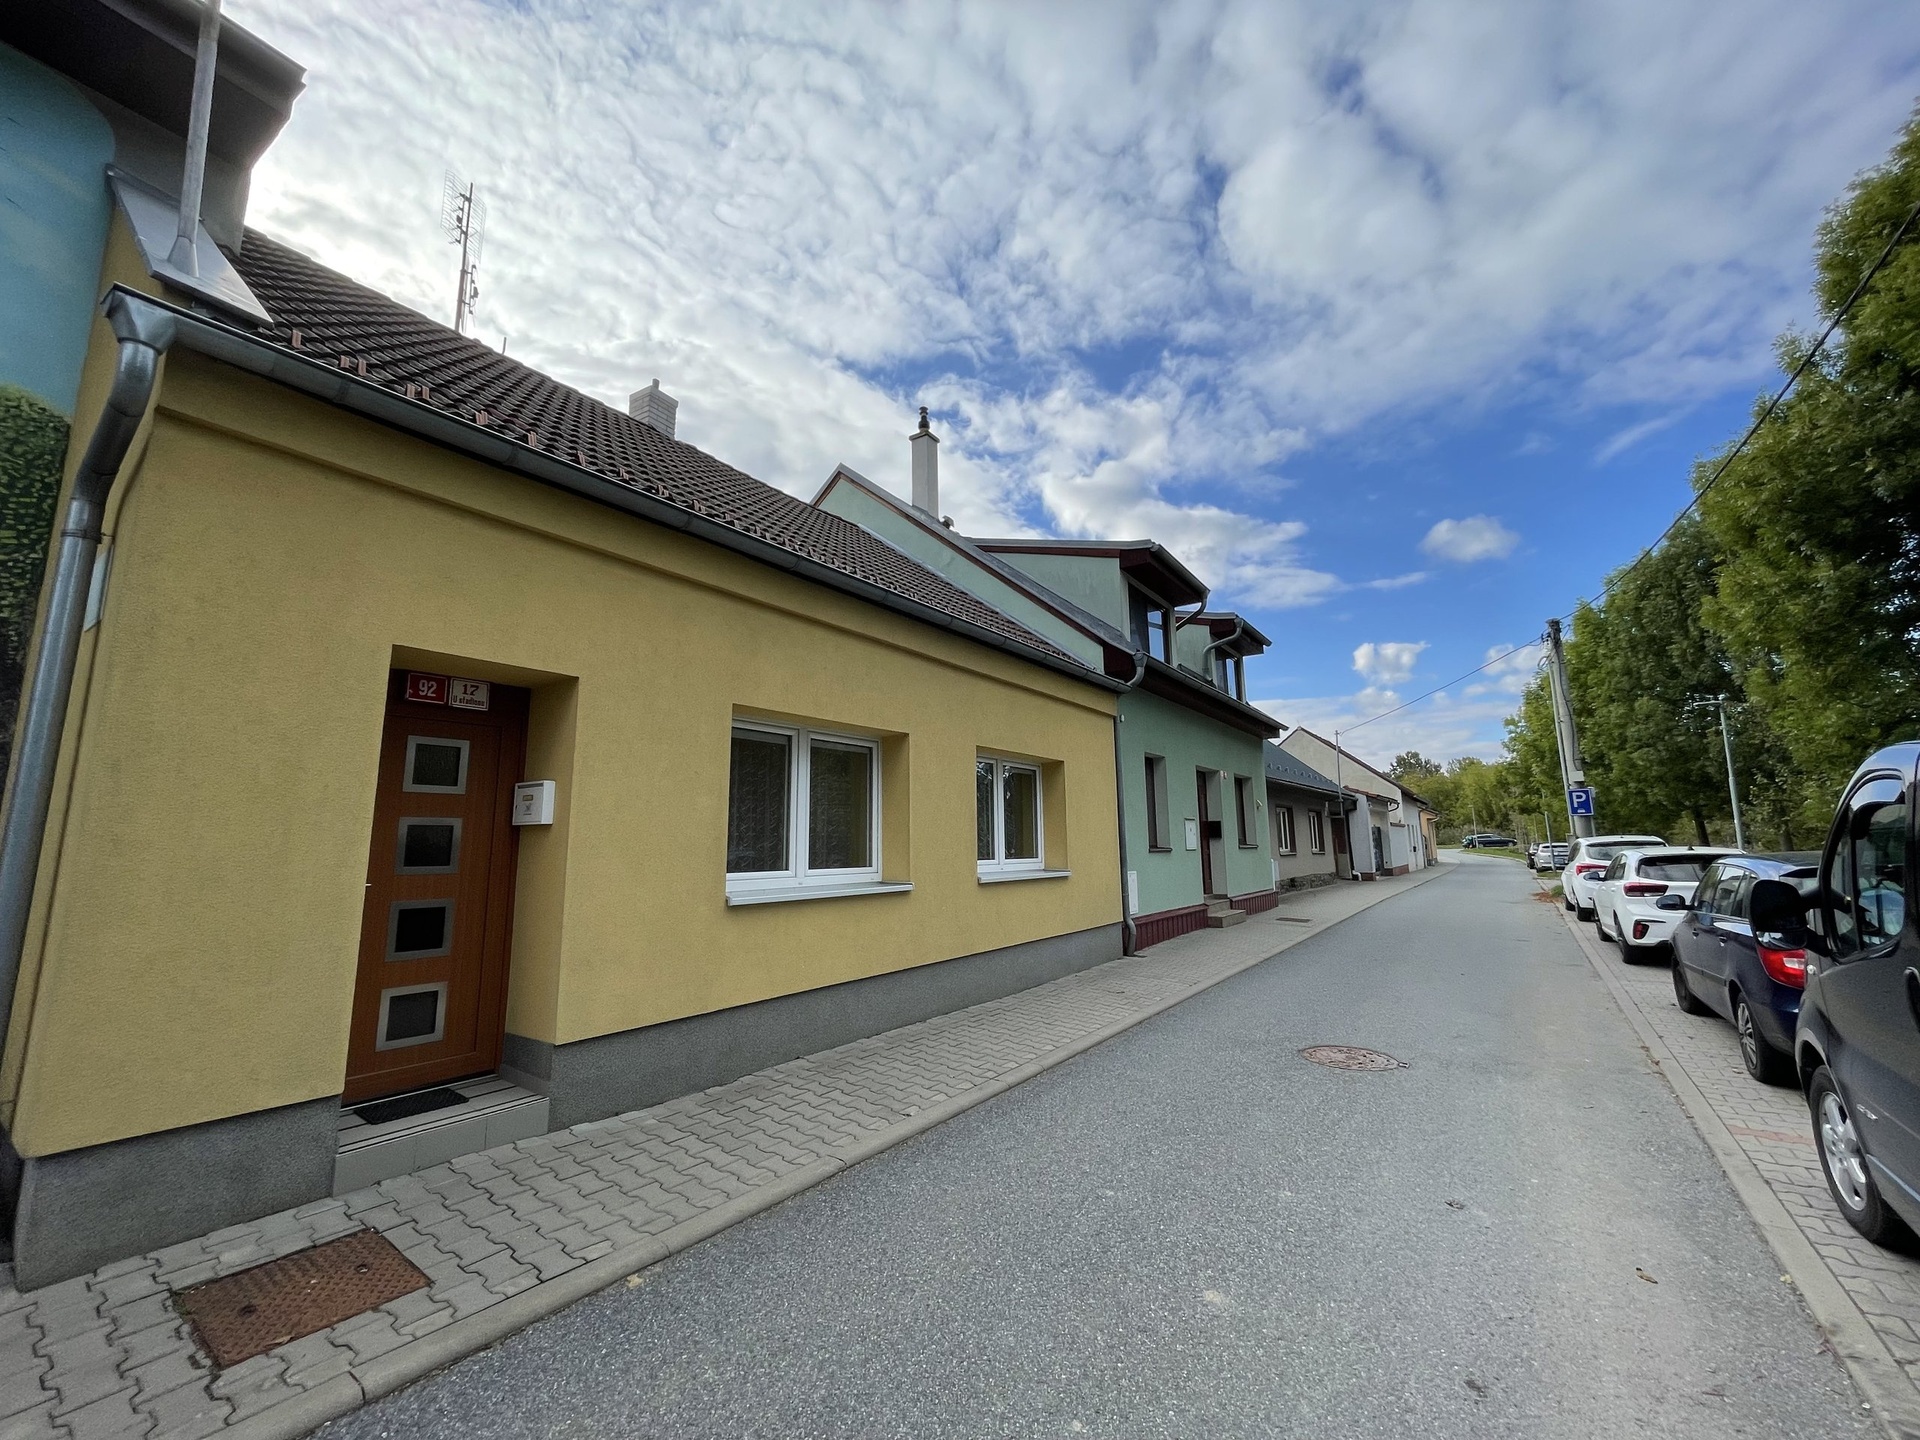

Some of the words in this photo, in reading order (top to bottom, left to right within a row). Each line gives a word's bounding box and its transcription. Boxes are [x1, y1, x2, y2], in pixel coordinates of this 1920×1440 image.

[418, 680, 437, 697] 92
[462, 683, 480, 696] 17
[453, 695, 458, 703] U
[1572, 792, 1587, 808] P
